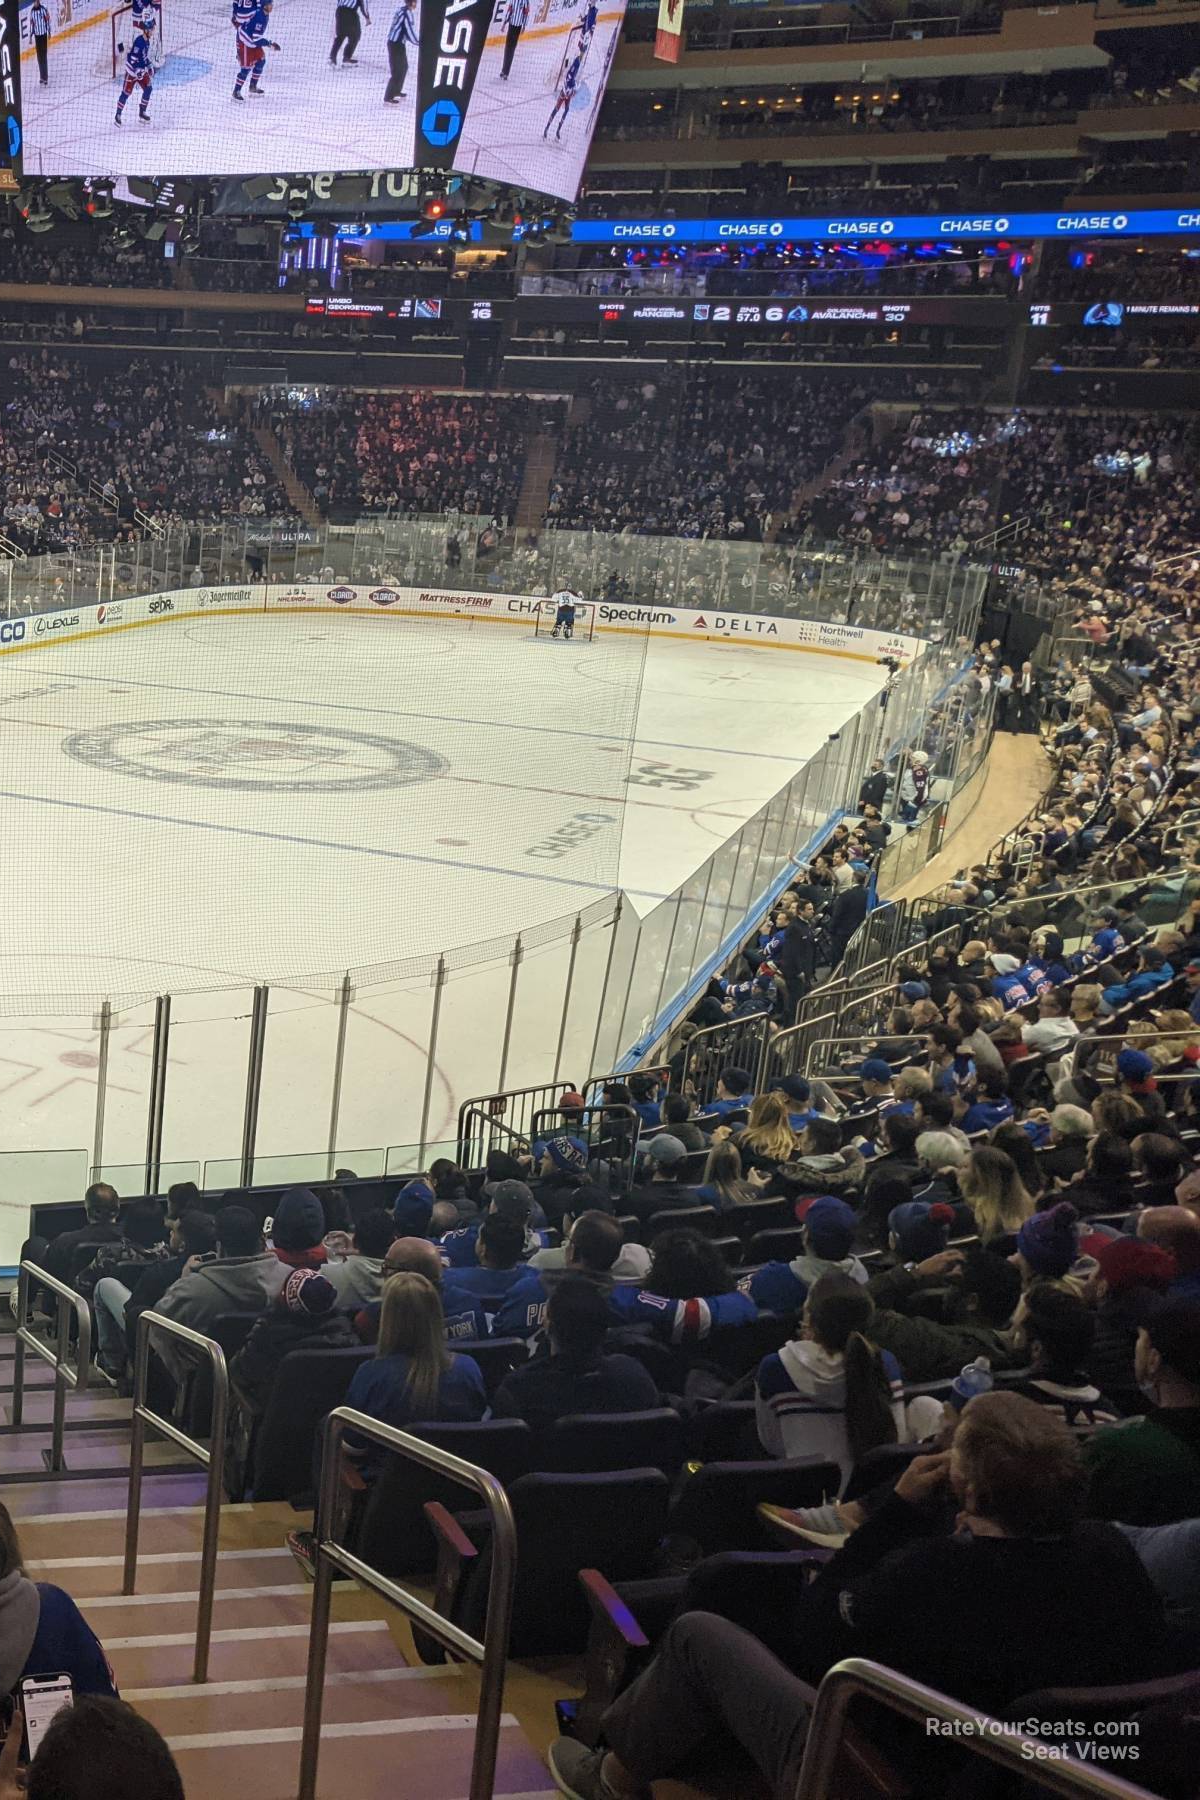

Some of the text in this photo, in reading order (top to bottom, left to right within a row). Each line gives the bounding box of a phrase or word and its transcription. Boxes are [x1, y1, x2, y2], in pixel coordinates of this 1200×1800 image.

[827, 222, 878, 234] CHASE
[940, 220, 992, 232] CHASE
[1057, 217, 1110, 230] CHASE
[613, 225, 660, 236] CHASE
[719, 224, 768, 236] CHASE
[471, 308, 492, 319] 16
[713, 307, 730, 321] 2
[736, 314, 761, 322] 57.0
[765, 307, 783, 321] 6
[885, 313, 905, 322] 30
[1031, 313, 1048, 325] 11
[281, 532, 311, 541] ULTRA
[330, 591, 354, 600] CLOROX
[372, 593, 397, 602] CLOROX
[507, 599, 557, 615] CHAS
[600, 605, 673, 624] Spectrum
[46, 616, 80, 630] LEXUS
[715, 617, 778, 635] DELTA
[819, 625, 864, 639] Northwell
[818, 636, 847, 647] Health
[450, 1320, 473, 1337] YORK
